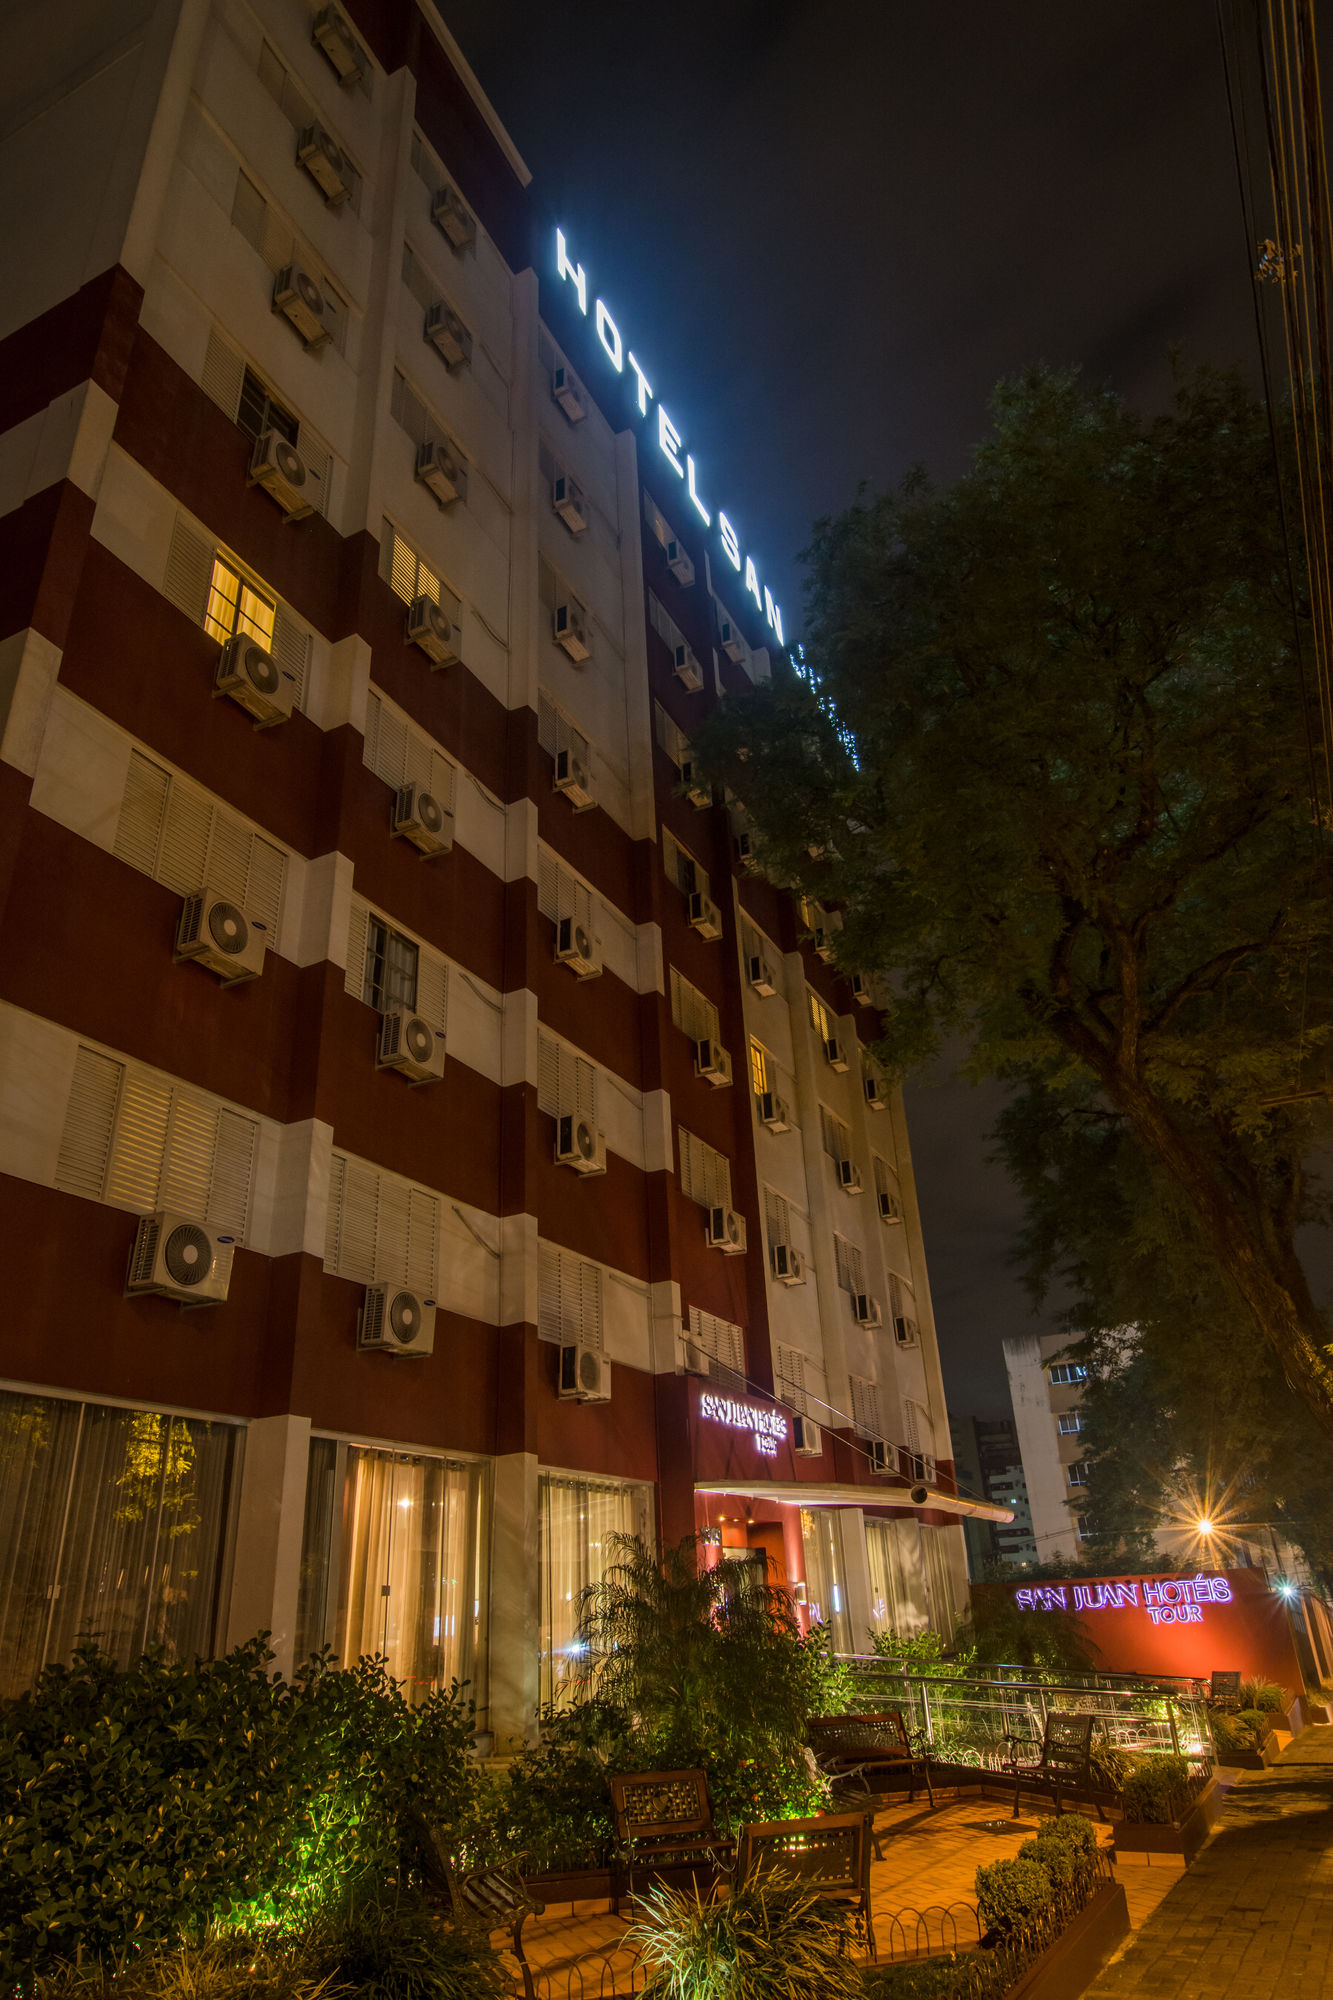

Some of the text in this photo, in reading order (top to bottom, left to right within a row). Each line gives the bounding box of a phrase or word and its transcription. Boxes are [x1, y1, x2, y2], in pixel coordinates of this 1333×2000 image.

[556, 228, 784, 646] HOTEL SAN
[1016, 1573, 1232, 1611] SAN JUAN HOTÉIS
[1149, 1604, 1203, 1625] TOUR
